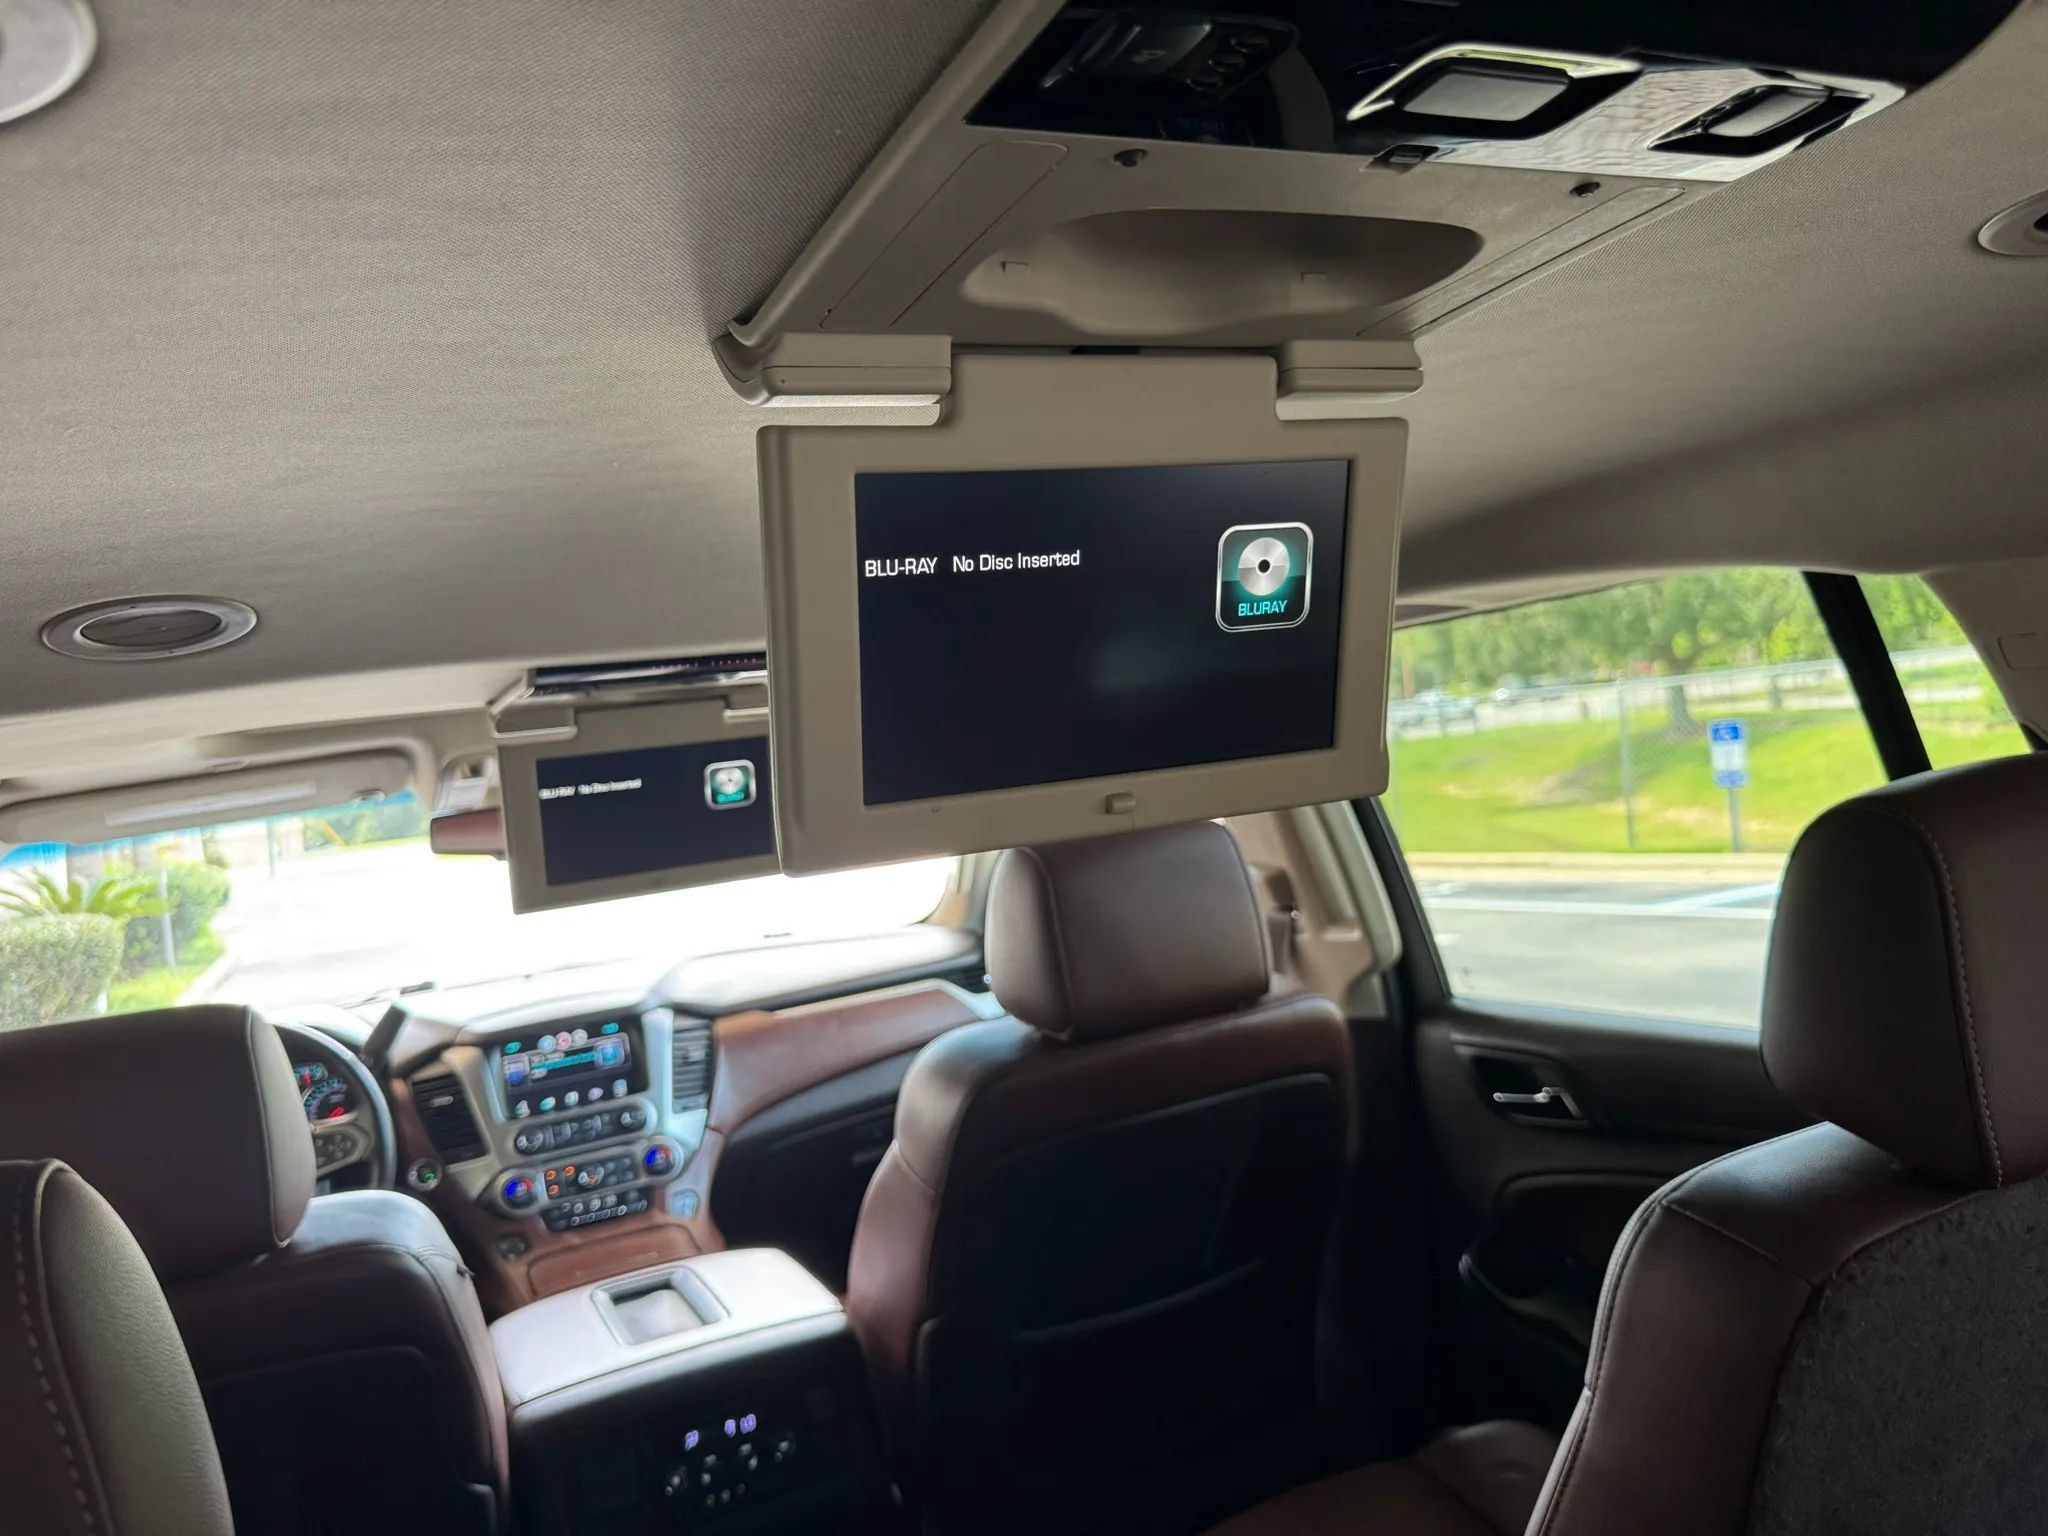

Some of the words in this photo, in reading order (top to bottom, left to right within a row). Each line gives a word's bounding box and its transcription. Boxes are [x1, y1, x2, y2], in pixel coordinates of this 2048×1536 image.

[864, 556, 938, 577] BLU-RAY
[952, 555, 974, 572] No
[979, 554, 1013, 571] Disc
[1018, 549, 1080, 569] Inserted
[1238, 600, 1288, 616] BLURAY
